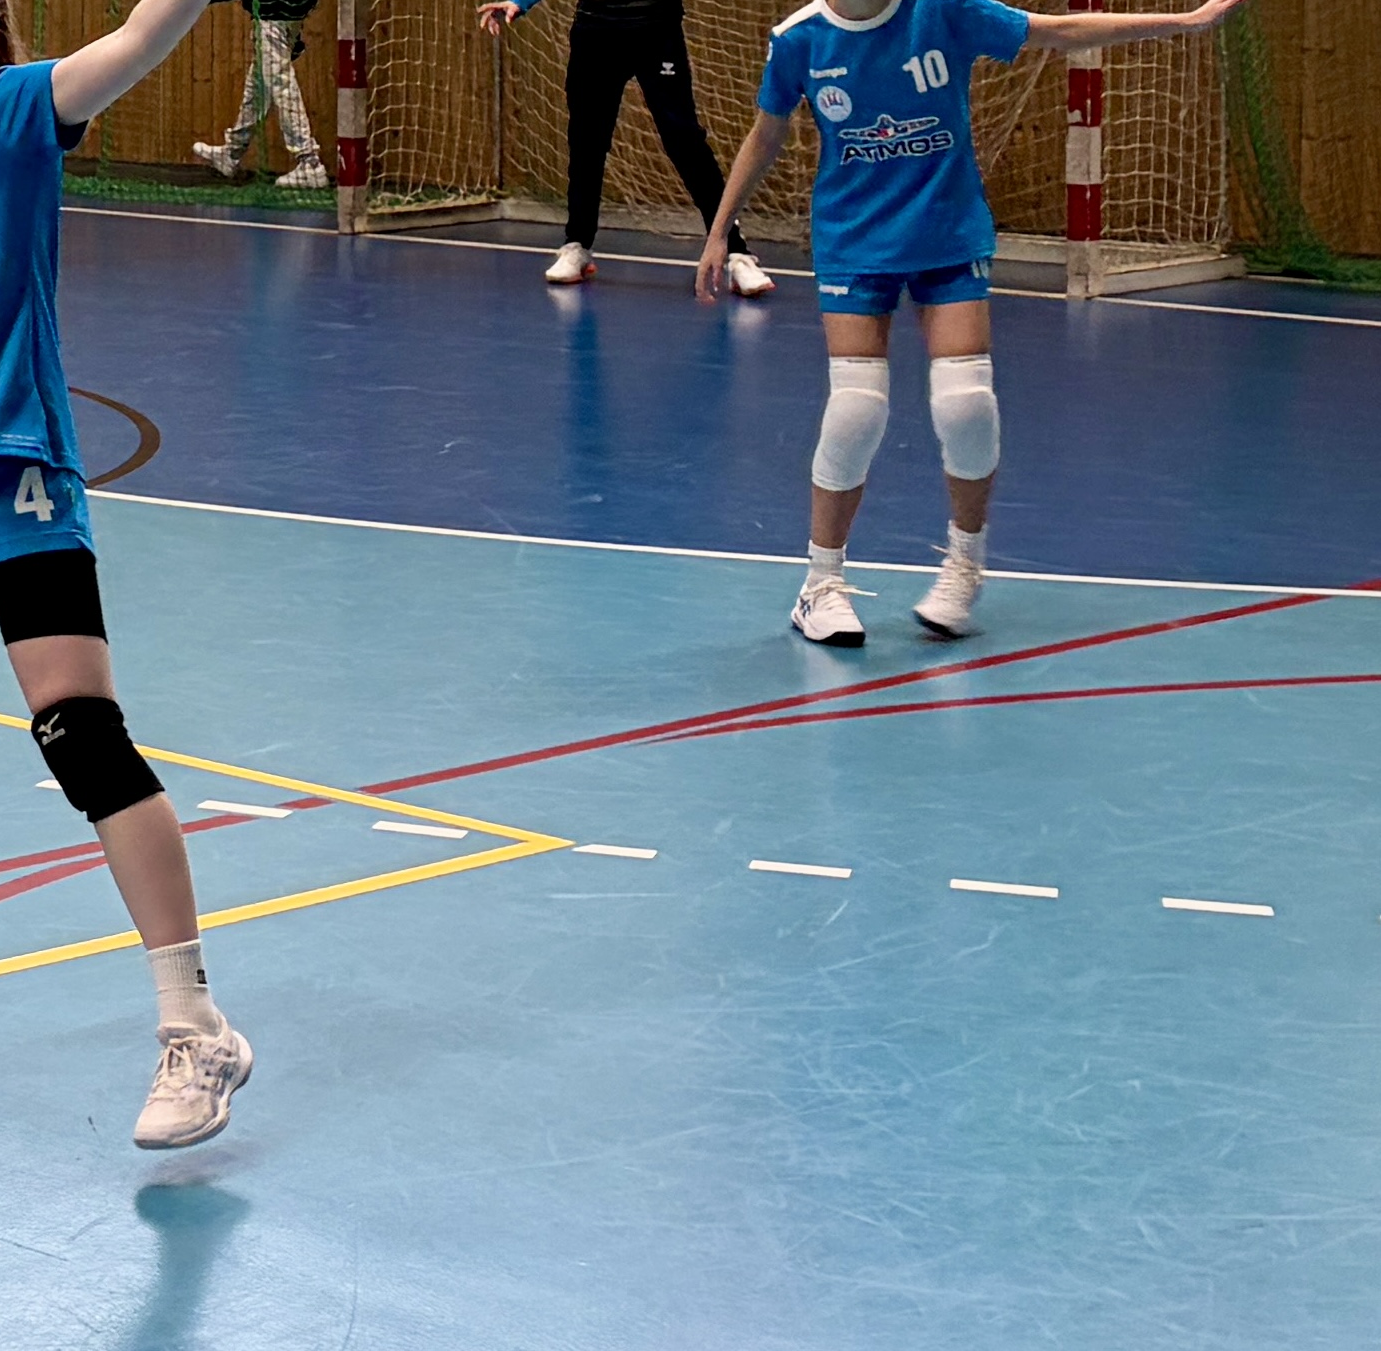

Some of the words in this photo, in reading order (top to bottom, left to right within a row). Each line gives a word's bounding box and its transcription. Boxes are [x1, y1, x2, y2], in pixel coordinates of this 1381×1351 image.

[902, 49, 950, 94] 10
[840, 130, 954, 165] ATMOS
[14, 465, 55, 523] 4
